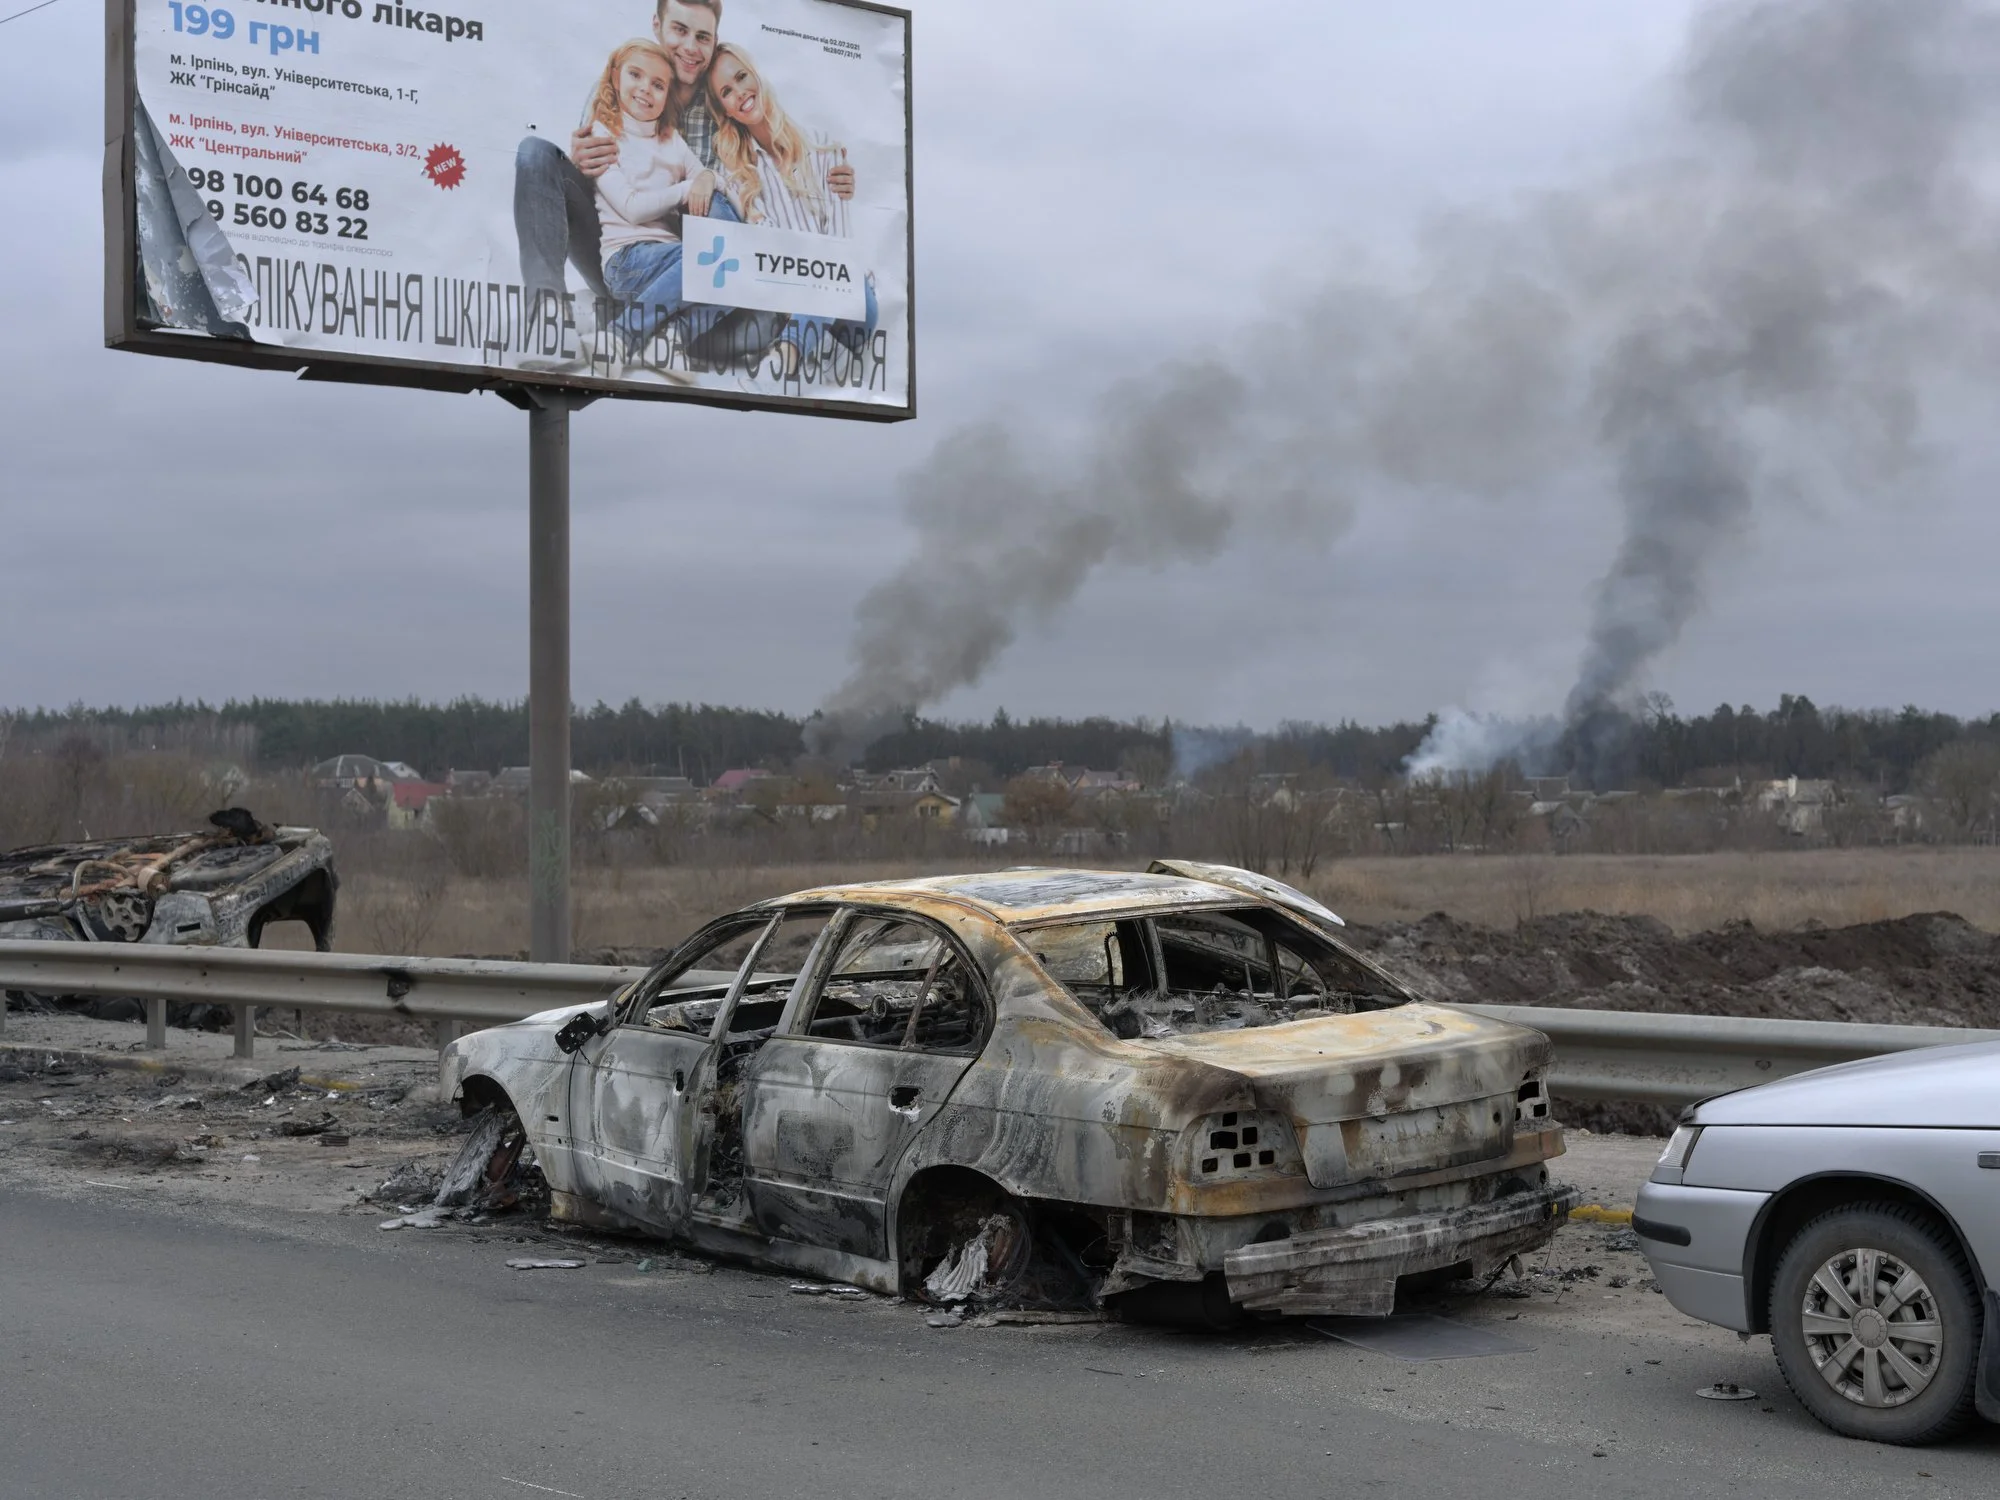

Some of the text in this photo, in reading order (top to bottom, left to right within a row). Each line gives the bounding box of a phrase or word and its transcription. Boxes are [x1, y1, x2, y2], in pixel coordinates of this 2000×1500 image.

[168, 1, 319, 55] 199 грн
[372, 0, 483, 42] лікаря
[170, 54, 418, 104] м. Ірпінь, вул. Університетська, 1-Г,
[170, 71, 196, 87] ЖК
[169, 113, 421, 160] м. Ірпінь, вул. Університетська, 3/2,
[169, 133, 195, 149] ЖК
[434, 156, 457, 175] NEW
[181, 167, 370, 211] 98 100 64 68
[233, 203, 287, 230] 560
[295, 211, 329, 235] 83
[337, 216, 369, 240] 22
[755, 253, 851, 282] ТУРБОТА
[435, 276, 576, 366] ШКІДЛИВЕ
[592, 297, 645, 378] ДЛЯ
[655, 304, 761, 379] ВАШОГО
